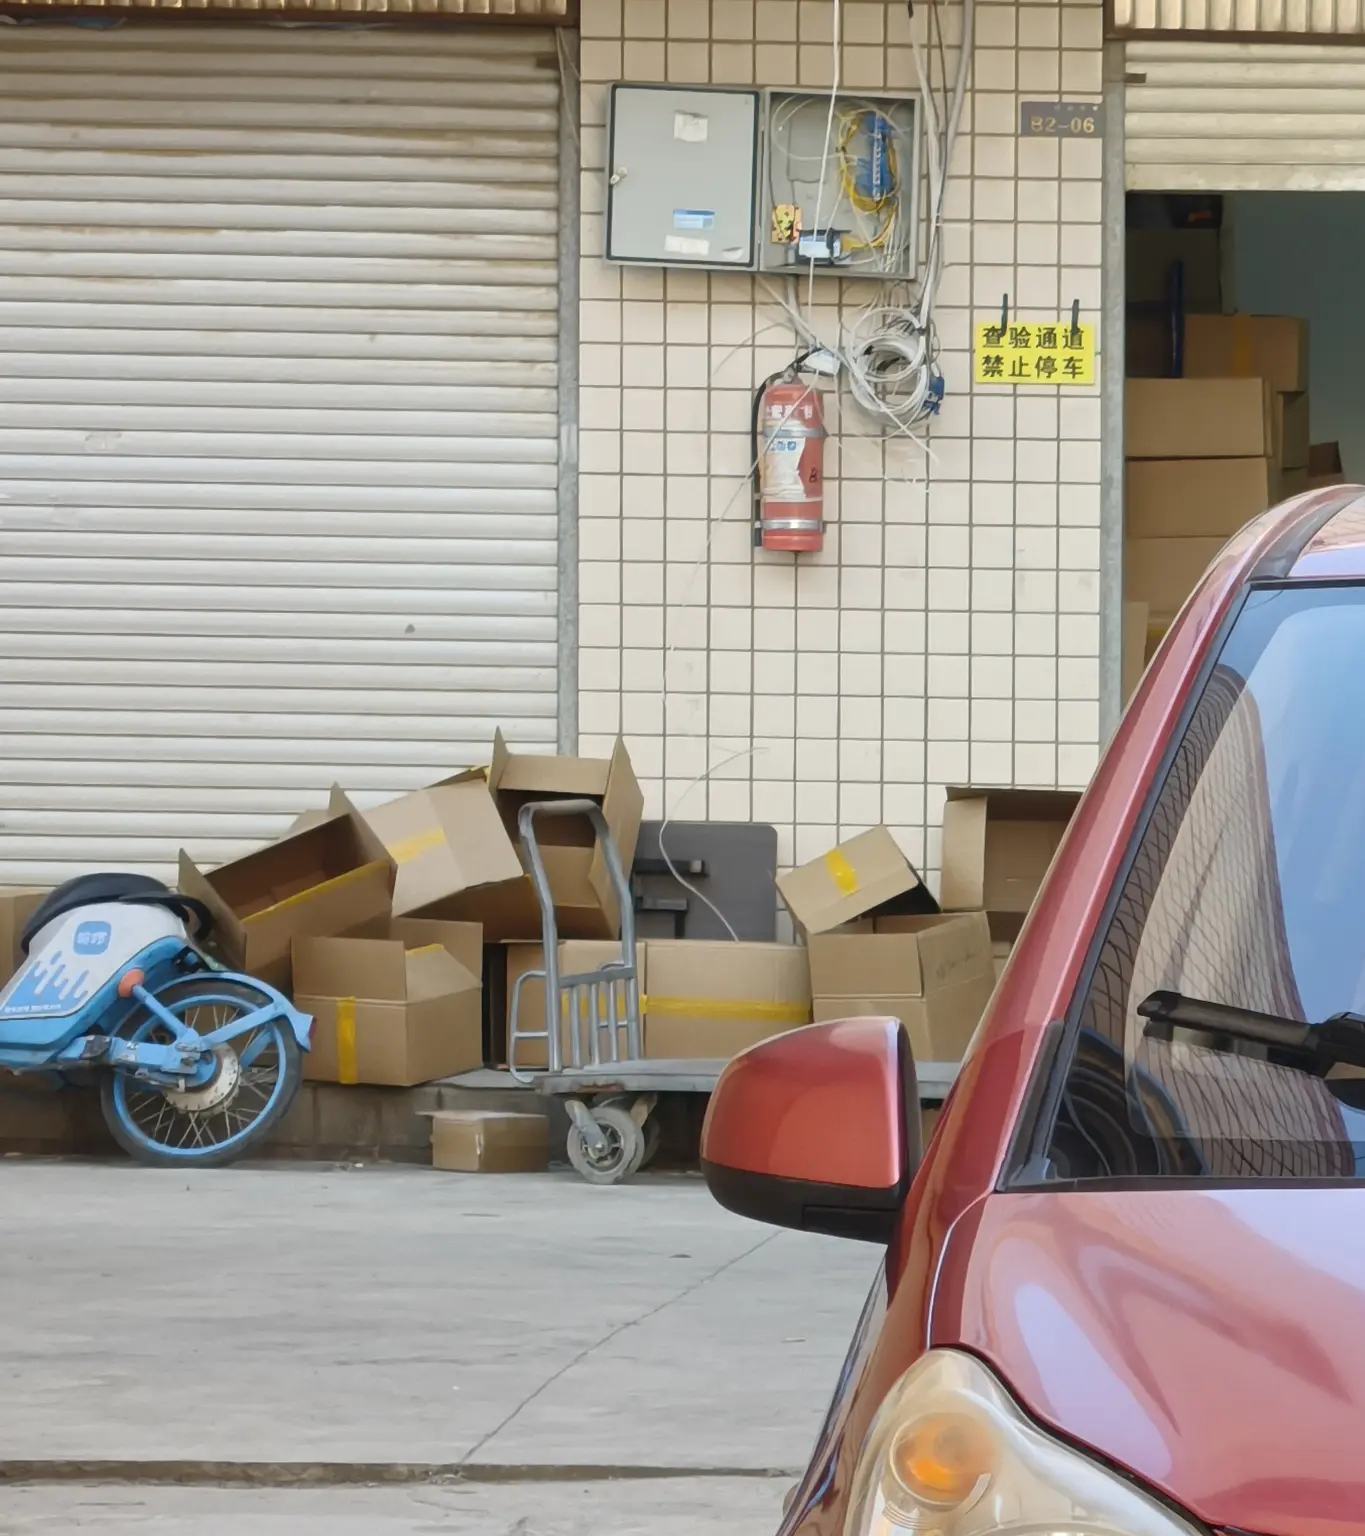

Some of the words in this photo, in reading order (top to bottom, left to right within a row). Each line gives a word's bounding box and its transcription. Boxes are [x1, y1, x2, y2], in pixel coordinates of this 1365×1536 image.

[982, 325, 1085, 350] 查验通道
[981, 354, 1084, 379] 禁止停车
